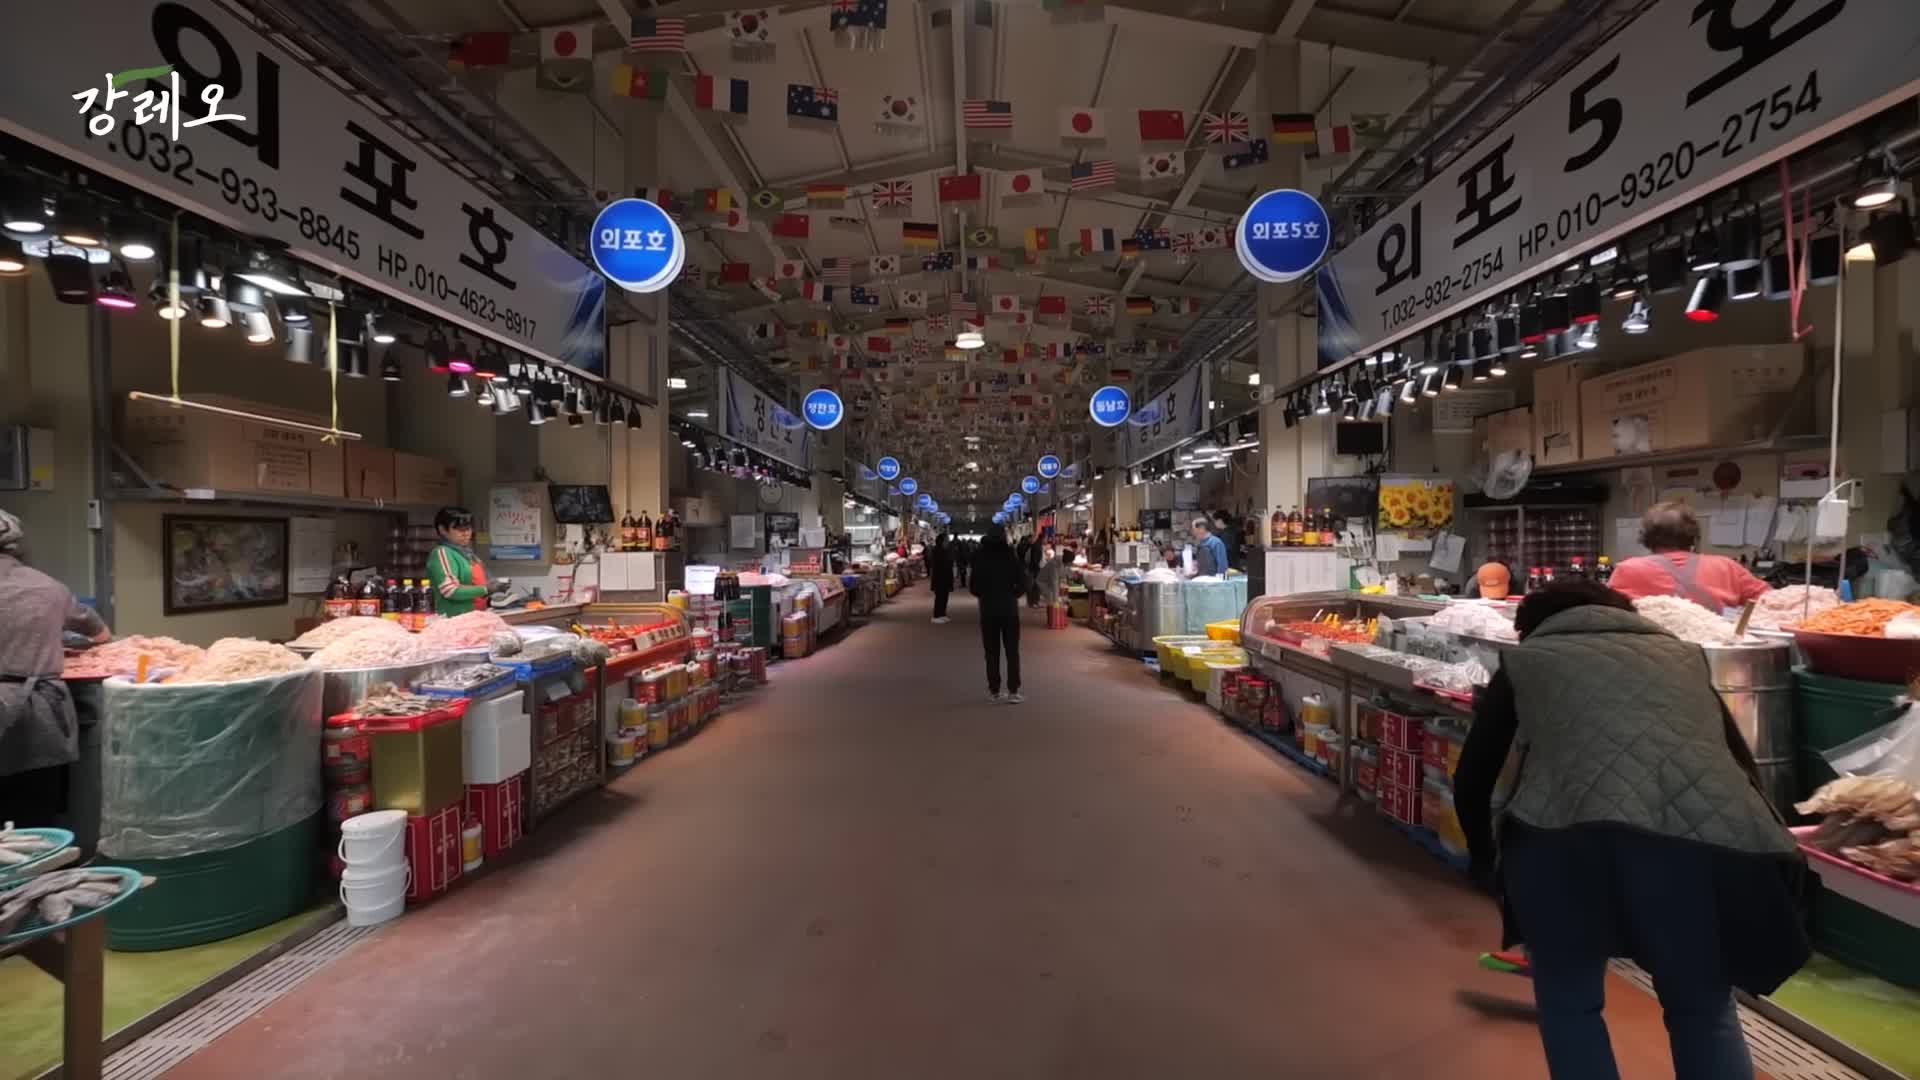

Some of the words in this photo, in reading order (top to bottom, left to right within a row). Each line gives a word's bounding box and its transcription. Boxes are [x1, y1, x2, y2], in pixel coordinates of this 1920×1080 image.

[340, 119, 425, 240] 포
[459, 202, 517, 291] 호
[599, 227, 668, 252] 외포호
[1252, 221, 1321, 241] 외포5호
[1375, 201, 1422, 297] 외
[1452, 133, 1523, 249] 포
[1563, 53, 1624, 173] 5
[1380, 246, 1504, 332] T.032-932-2754
[1518, 69, 1823, 262] HP.010-9320-2754
[377, 244, 537, 341] HP.010-4623-8917
